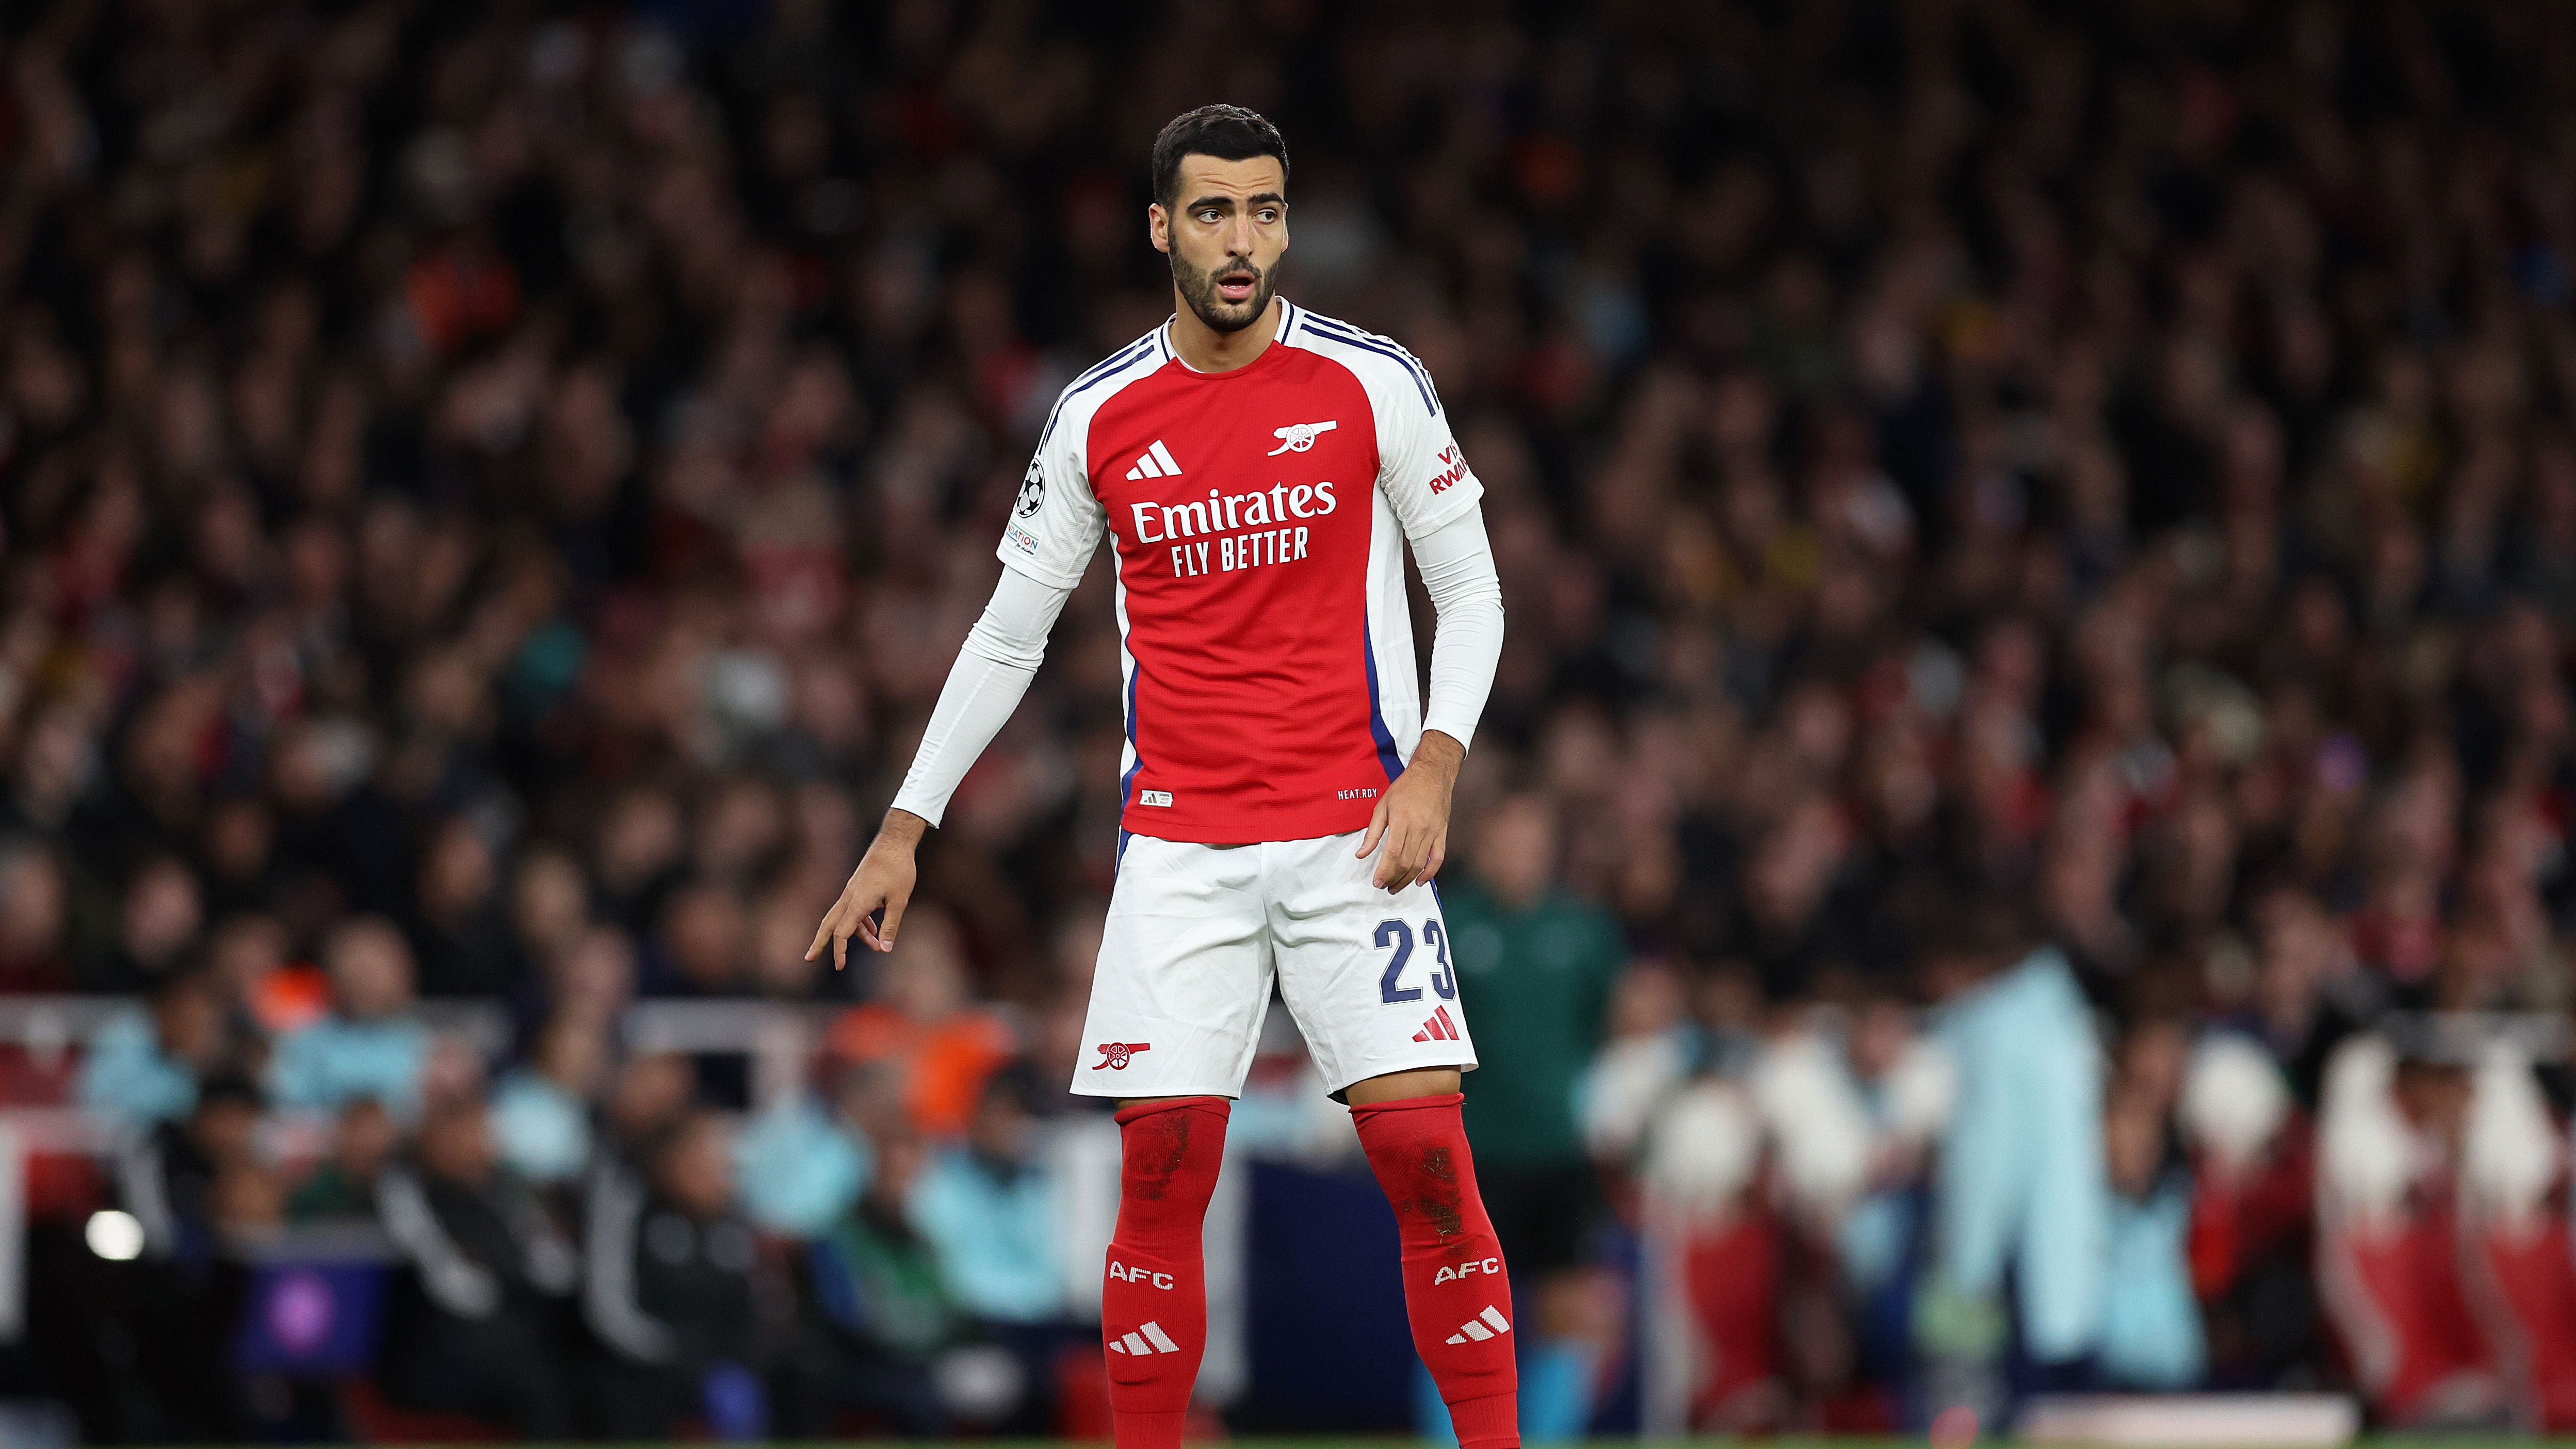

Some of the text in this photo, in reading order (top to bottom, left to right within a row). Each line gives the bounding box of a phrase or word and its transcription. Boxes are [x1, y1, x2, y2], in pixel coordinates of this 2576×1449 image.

[1130, 481, 1337, 543] Emirates
[1008, 523, 1038, 549] NDATION
[1171, 526, 1308, 577] FLY BETTER
[1338, 788, 1377, 800] HEAT.RDY
[1372, 918, 1457, 1005] 23
[1110, 1261, 1173, 1290] AFC
[1435, 1257, 1499, 1285] AFC
